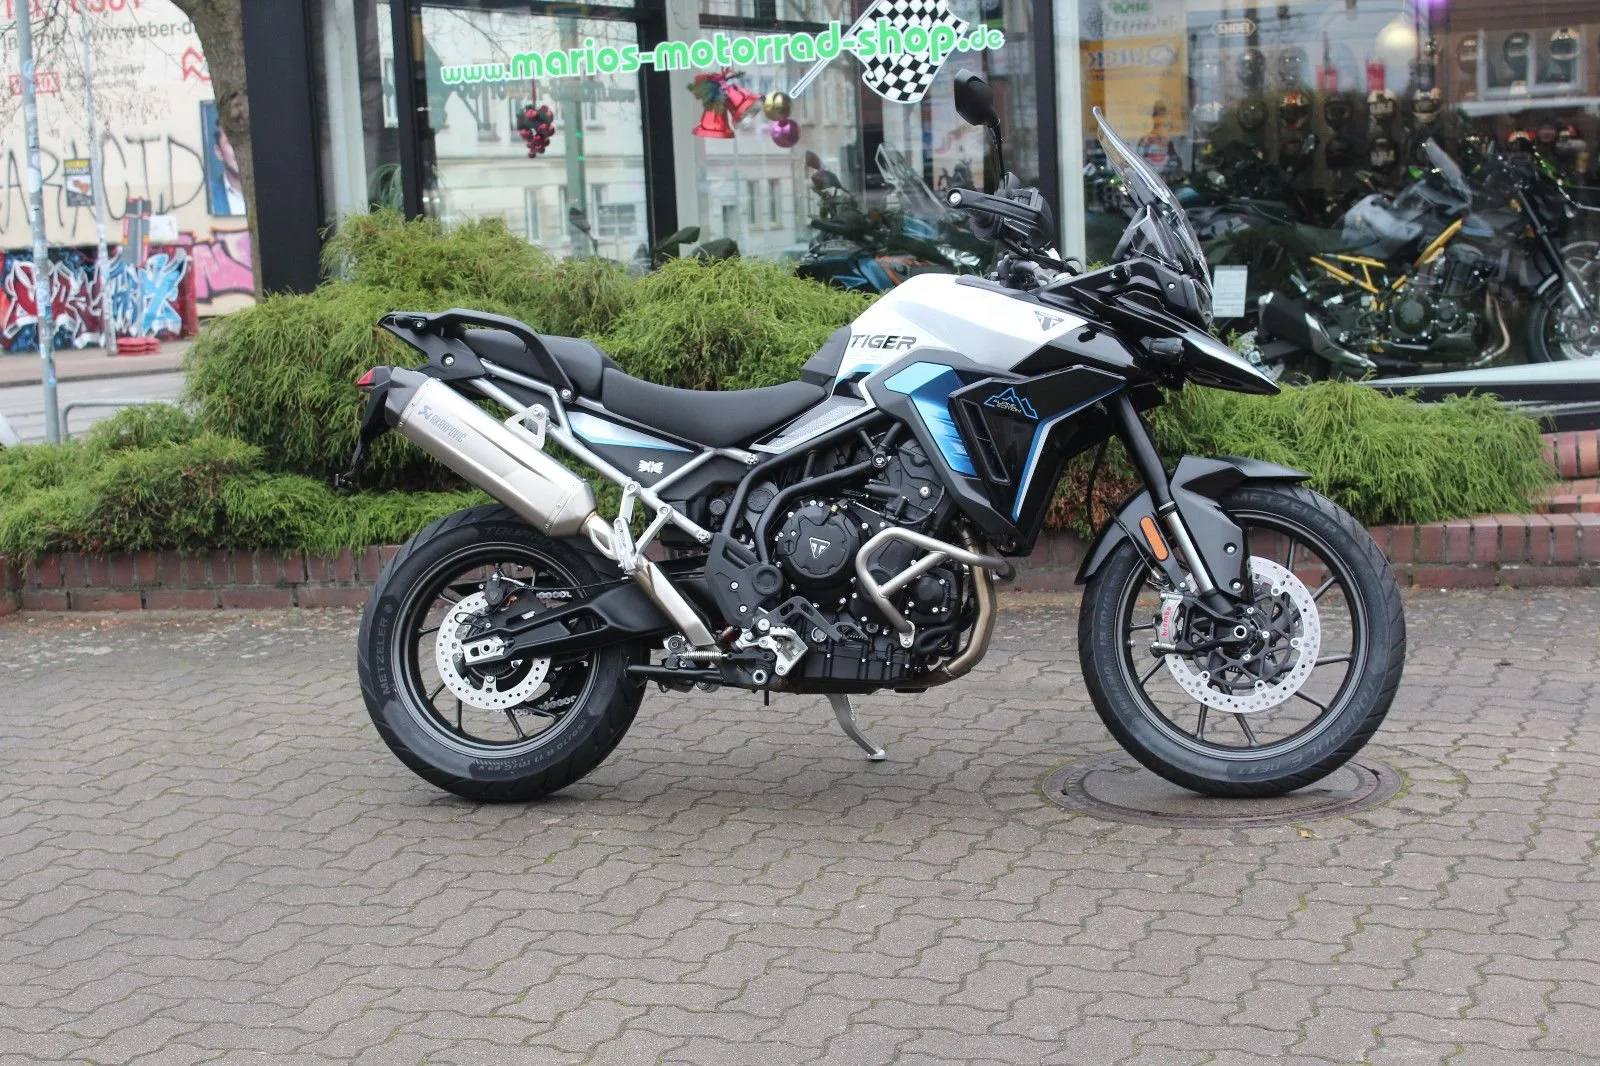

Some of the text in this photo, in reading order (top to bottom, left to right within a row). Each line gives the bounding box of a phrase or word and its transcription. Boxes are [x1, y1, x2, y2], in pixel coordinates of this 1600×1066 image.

[440, 17, 1005, 84] www.marios-motorrad-shop.de
[851, 334, 917, 350] TIGER
[375, 616, 391, 696] METZELER
